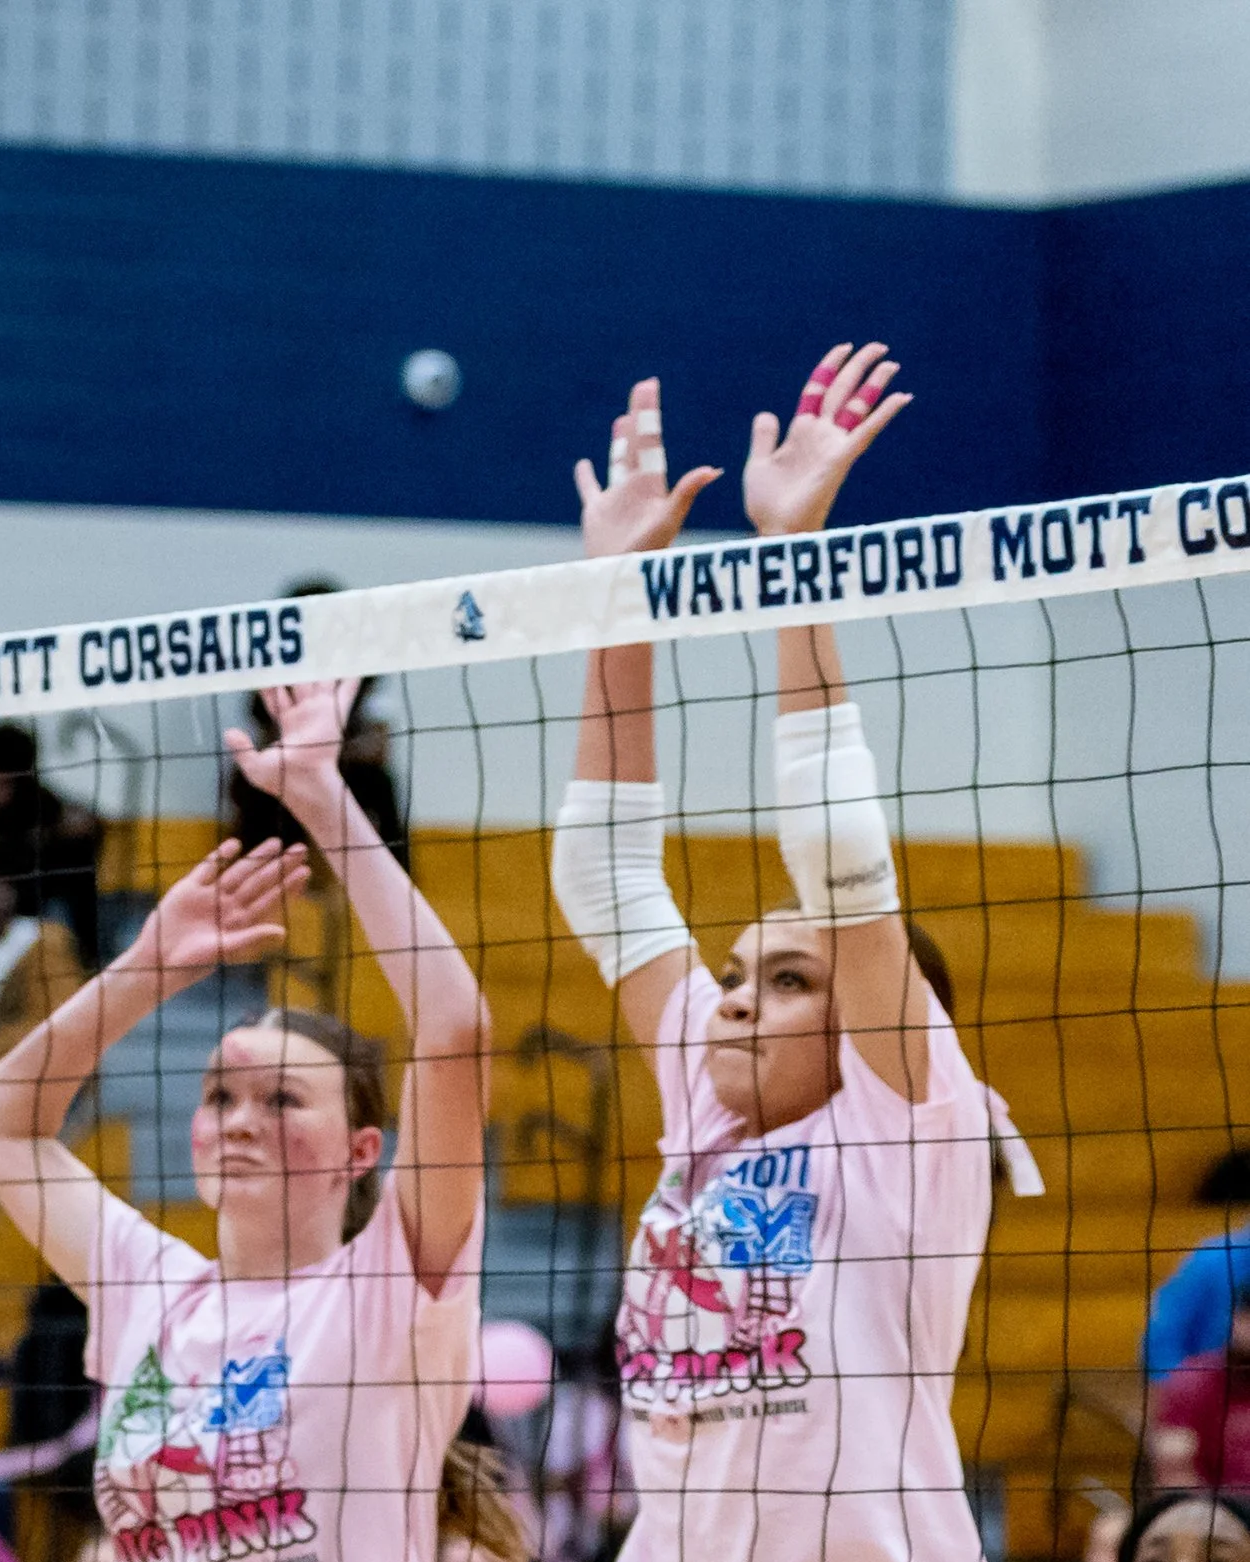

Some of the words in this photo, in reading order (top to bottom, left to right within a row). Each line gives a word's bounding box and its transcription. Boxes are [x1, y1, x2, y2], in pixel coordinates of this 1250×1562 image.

[640, 521, 963, 620] WATERFORD
[989, 495, 1152, 582] MOTT
[1179, 482, 1250, 557] CO
[78, 604, 303, 688] CORSAIRS
